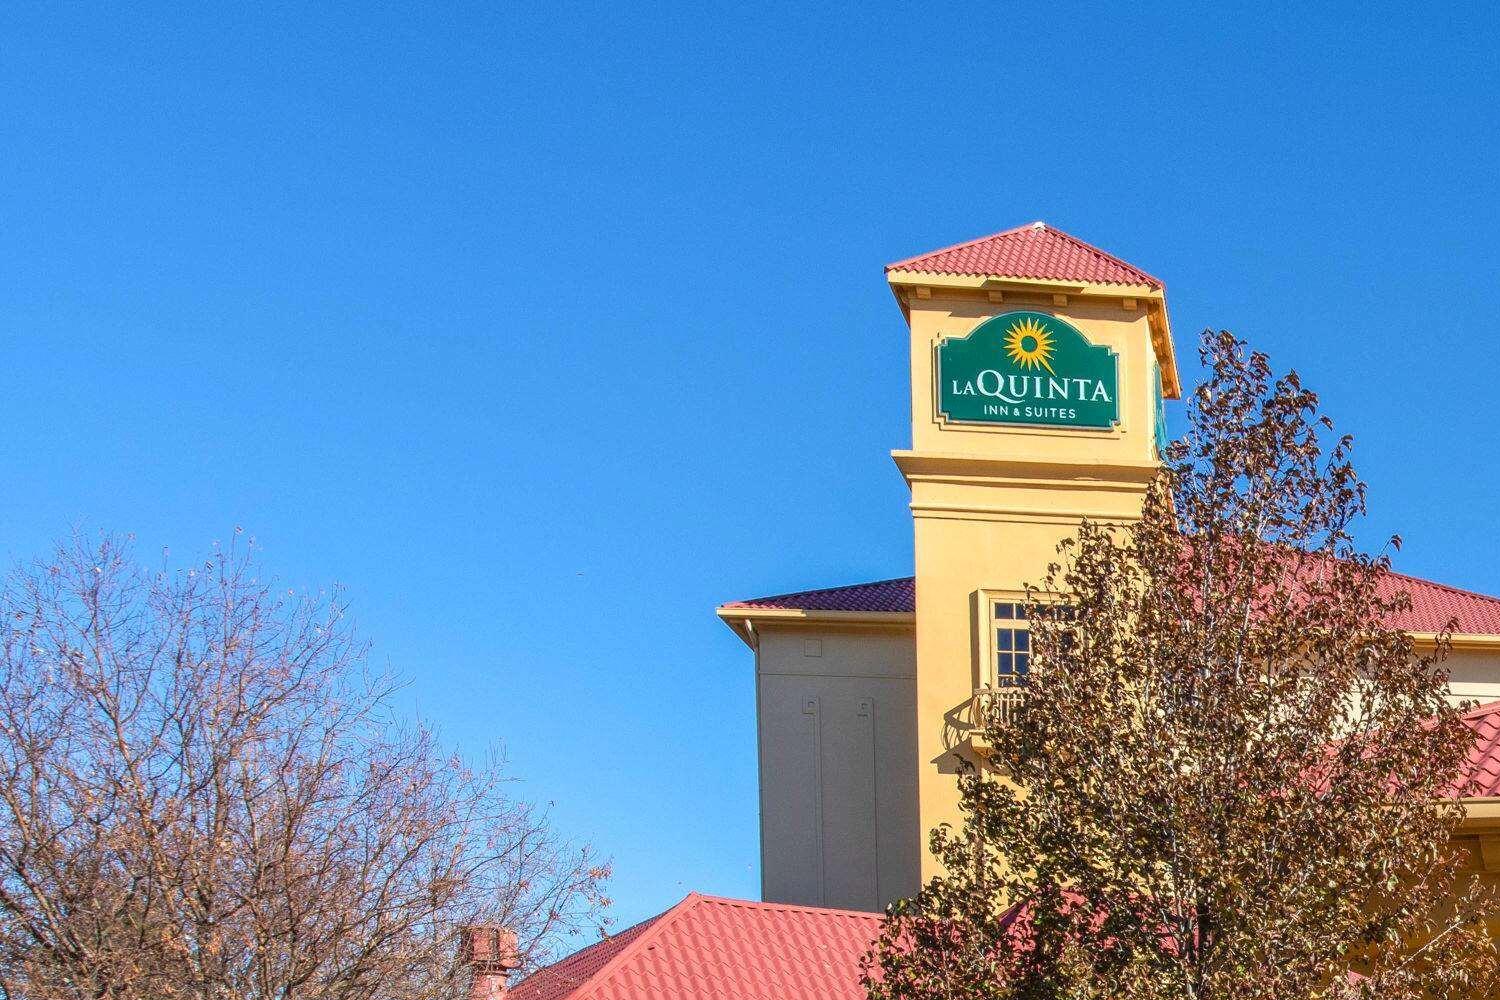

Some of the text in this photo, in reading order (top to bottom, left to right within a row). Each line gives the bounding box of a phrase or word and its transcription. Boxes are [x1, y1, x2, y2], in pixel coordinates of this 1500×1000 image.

[984, 404, 1076, 419] INN & SUITES
